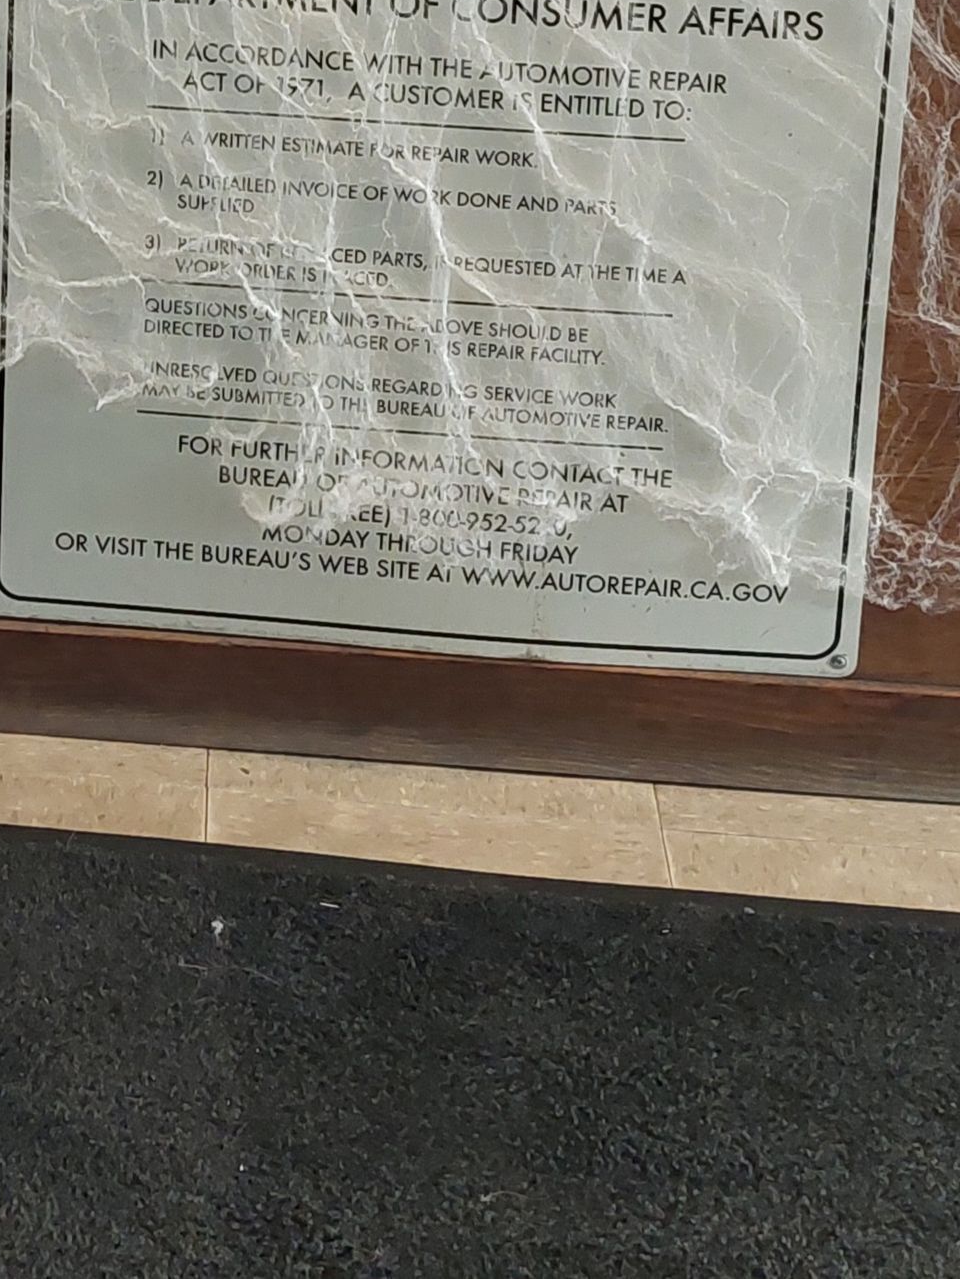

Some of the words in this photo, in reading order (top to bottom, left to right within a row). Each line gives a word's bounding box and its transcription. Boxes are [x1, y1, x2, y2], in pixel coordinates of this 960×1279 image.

[678, 5, 825, 42] AFFAIRS
[152, 38, 178, 61] IN
[184, 41, 356, 73] ACCORDANCE
[361, 53, 423, 78] WITH
[429, 56, 473, 81] THE
[648, 72, 728, 96] REPAIR
[182, 69, 229, 94] ACT
[347, 81, 367, 102] A
[373, 82, 505, 111] CUSTOMER
[541, 94, 646, 120] ENTITLED
[654, 99, 693, 122] TO:
[411, 145, 470, 164] REPAIR
[474, 148, 539, 169] WORK.
[147, 169, 165, 190] 2)
[179, 173, 193, 189] A
[282, 179, 359, 200] INVOICE
[363, 185, 391, 202] OF
[457, 192, 513, 210] DONE
[517, 195, 560, 213] AND
[144, 233, 162, 251] 3)
[372, 249, 430, 272] PARTS,
[453, 256, 557, 278] REQUESTED
[671, 270, 687, 285] A
[302, 266, 317, 283] IS
[144, 297, 248, 321] QUESTIONS
[568, 327, 589, 343] BE
[144, 319, 225, 339] DIRECTED
[230, 325, 254, 342] TO
[394, 336, 420, 354] OF
[467, 341, 525, 361] REPAIR
[530, 346, 607, 367] FACILITY.
[375, 398, 446, 419] BUREAU
[481, 406, 602, 431] AUTOMOTIVE
[605, 414, 670, 435] REPAIR.
[483, 383, 555, 405] SERVICE
[559, 390, 618, 409] WORK
[177, 434, 223, 457] FOR
[511, 458, 626, 488] CONTACT
[630, 467, 674, 490] THE
[600, 493, 630, 515] AT
[261, 523, 371, 550] MONDAY
[500, 541, 580, 565] FRIDAY
[55, 532, 89, 553] OR
[94, 534, 148, 558] VISIT
[152, 540, 195, 562] THE
[200, 544, 312, 572] BUREAU'S
[318, 553, 370, 577] WEB
[376, 558, 421, 582] SITE
[426, 563, 452, 585] AT
[461, 565, 791, 605] WWW.AUTOREPAIR.CA.GOV
